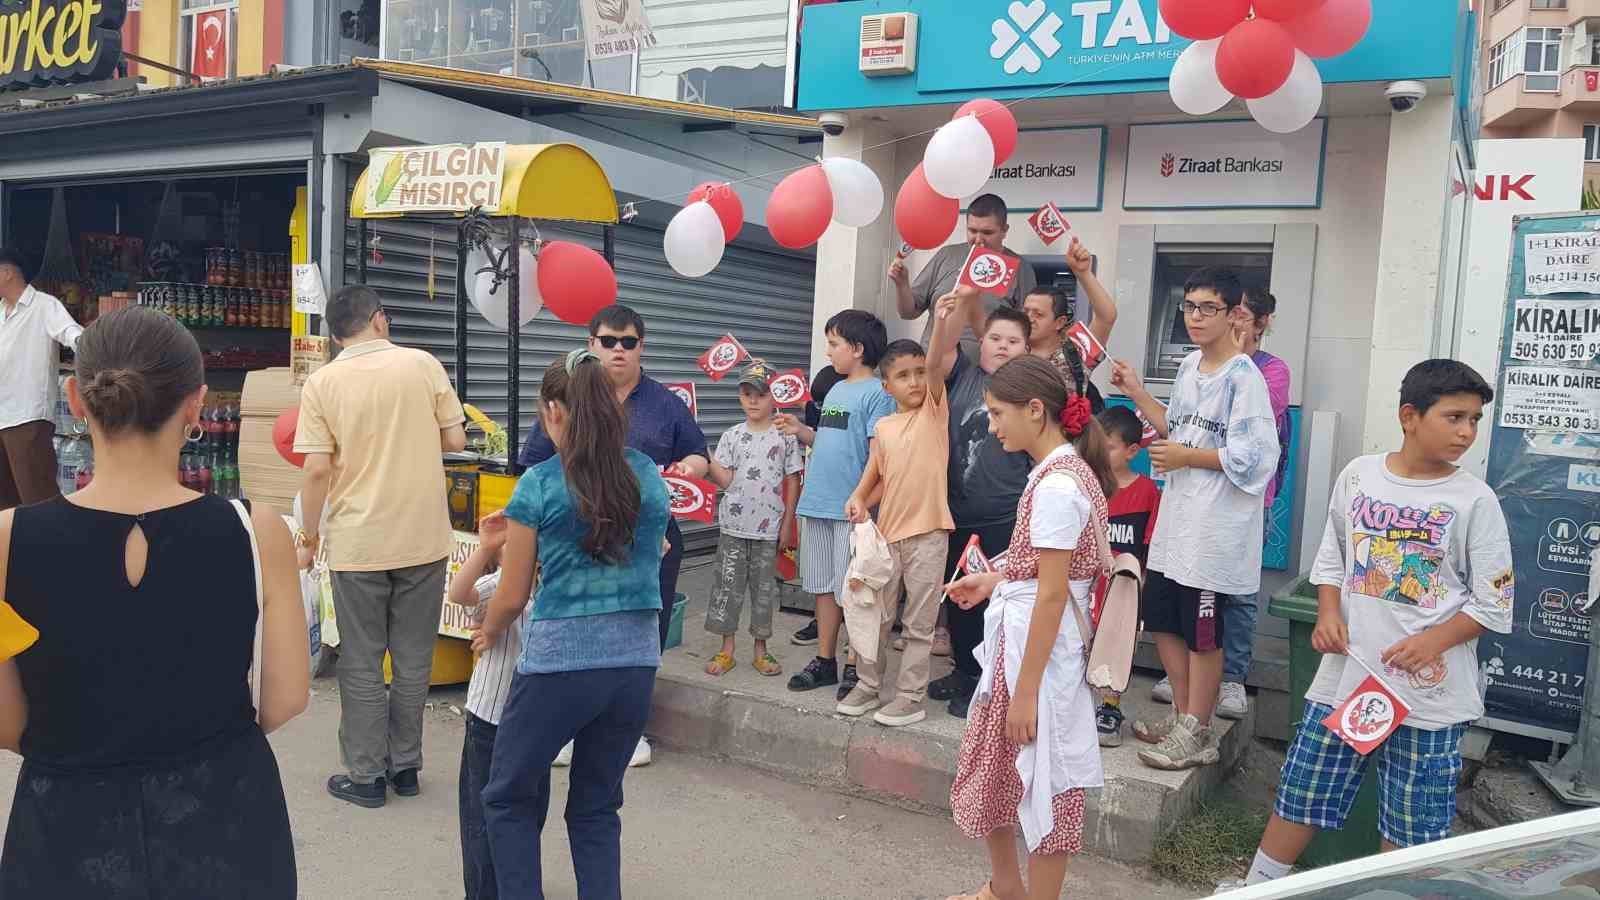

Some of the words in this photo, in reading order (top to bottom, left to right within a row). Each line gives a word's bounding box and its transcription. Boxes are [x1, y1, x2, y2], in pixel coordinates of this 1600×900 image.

[1134, 51, 1154, 61] ATM
[1159, 48, 1181, 60] MER
[403, 147, 500, 182] ÇILGIN
[989, 164, 1023, 179] iraat
[1025, 162, 1077, 178] Bankası
[1178, 158, 1222, 173] Ziraat
[1224, 156, 1284, 173] Bankası
[400, 180, 497, 206] MISIRCI
[1515, 342, 1539, 359] 505
[1542, 343, 1566, 360] 630
[1570, 343, 1585, 359] 50
[1507, 369, 1560, 388] KİRALIK
[1563, 372, 1600, 390] DAİRE
[1504, 412, 1534, 426] 0533
[1537, 414, 1560, 428] 543
[1564, 416, 1580, 429] 30
[1549, 543, 1579, 555] GİYSİ
[1512, 665, 1544, 680] 444
[1547, 670, 1567, 685] 21
